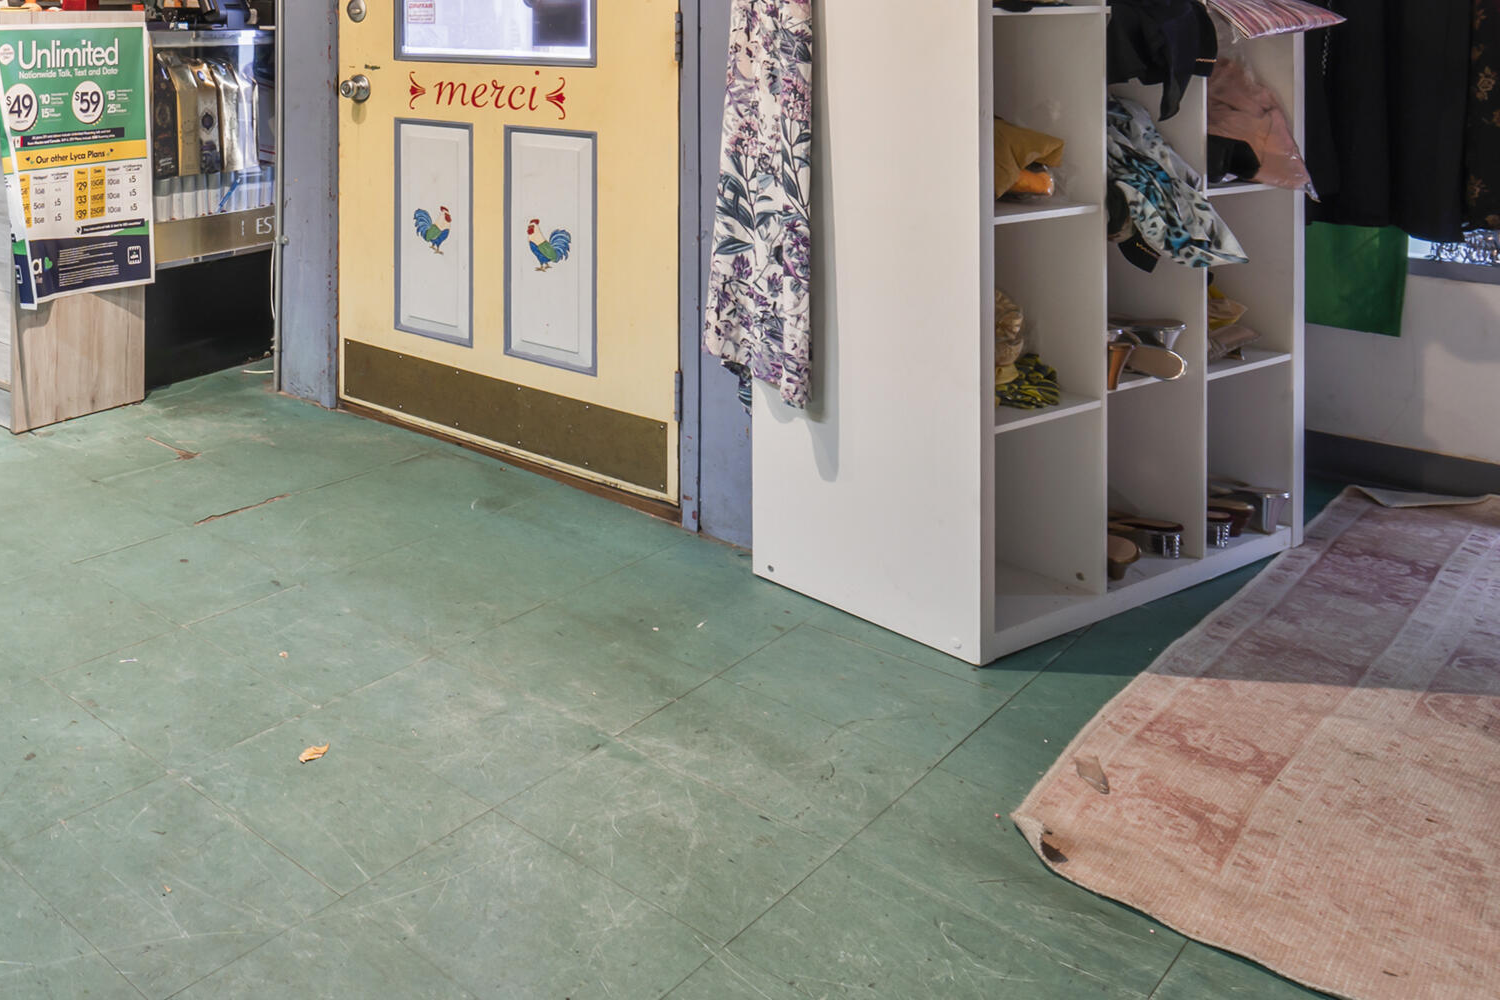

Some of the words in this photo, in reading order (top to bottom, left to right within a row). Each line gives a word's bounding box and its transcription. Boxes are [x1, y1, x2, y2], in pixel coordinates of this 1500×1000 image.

[18, 38, 119, 70] Unlimited
[19, 71, 57, 80] Nationwide
[58, 70, 73, 78] Talk,
[74, 69, 87, 77] Text
[433, 69, 539, 111] merci
[6, 94, 34, 118] $49
[75, 91, 101, 114] $59
[36, 155, 49, 164] Our
[51, 153, 68, 163] other
[70, 151, 86, 161] Lyca
[88, 150, 105, 159] Plans
[256, 215, 276, 235] ES
